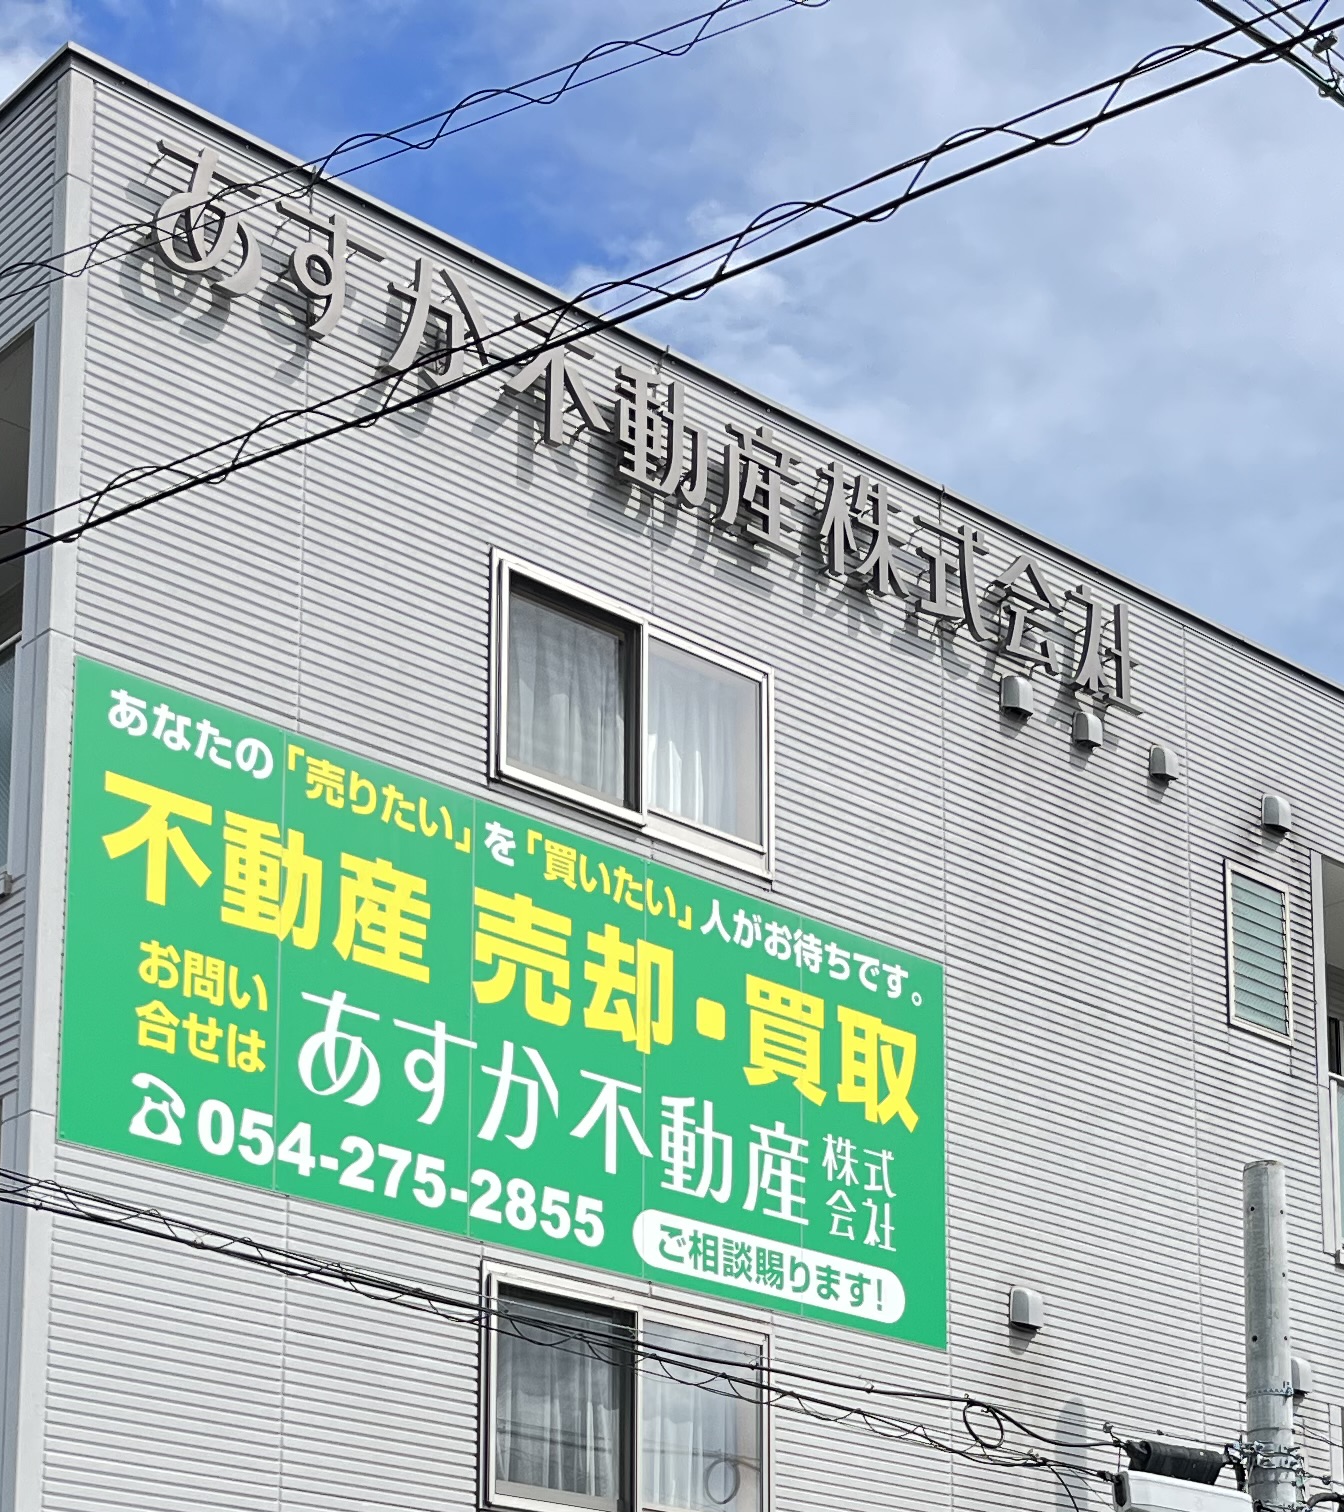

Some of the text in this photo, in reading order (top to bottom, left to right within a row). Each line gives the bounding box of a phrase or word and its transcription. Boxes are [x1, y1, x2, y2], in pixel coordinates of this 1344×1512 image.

[156, 139, 1144, 717] あすか不動産株式会社
[102, 770, 432, 984] 不動産
[135, 999, 267, 1073] 合せは
[138, 939, 269, 1012] お問い
[197, 1098, 605, 1248] 054-275-2855
[297, 989, 809, 1226] あすか不動産
